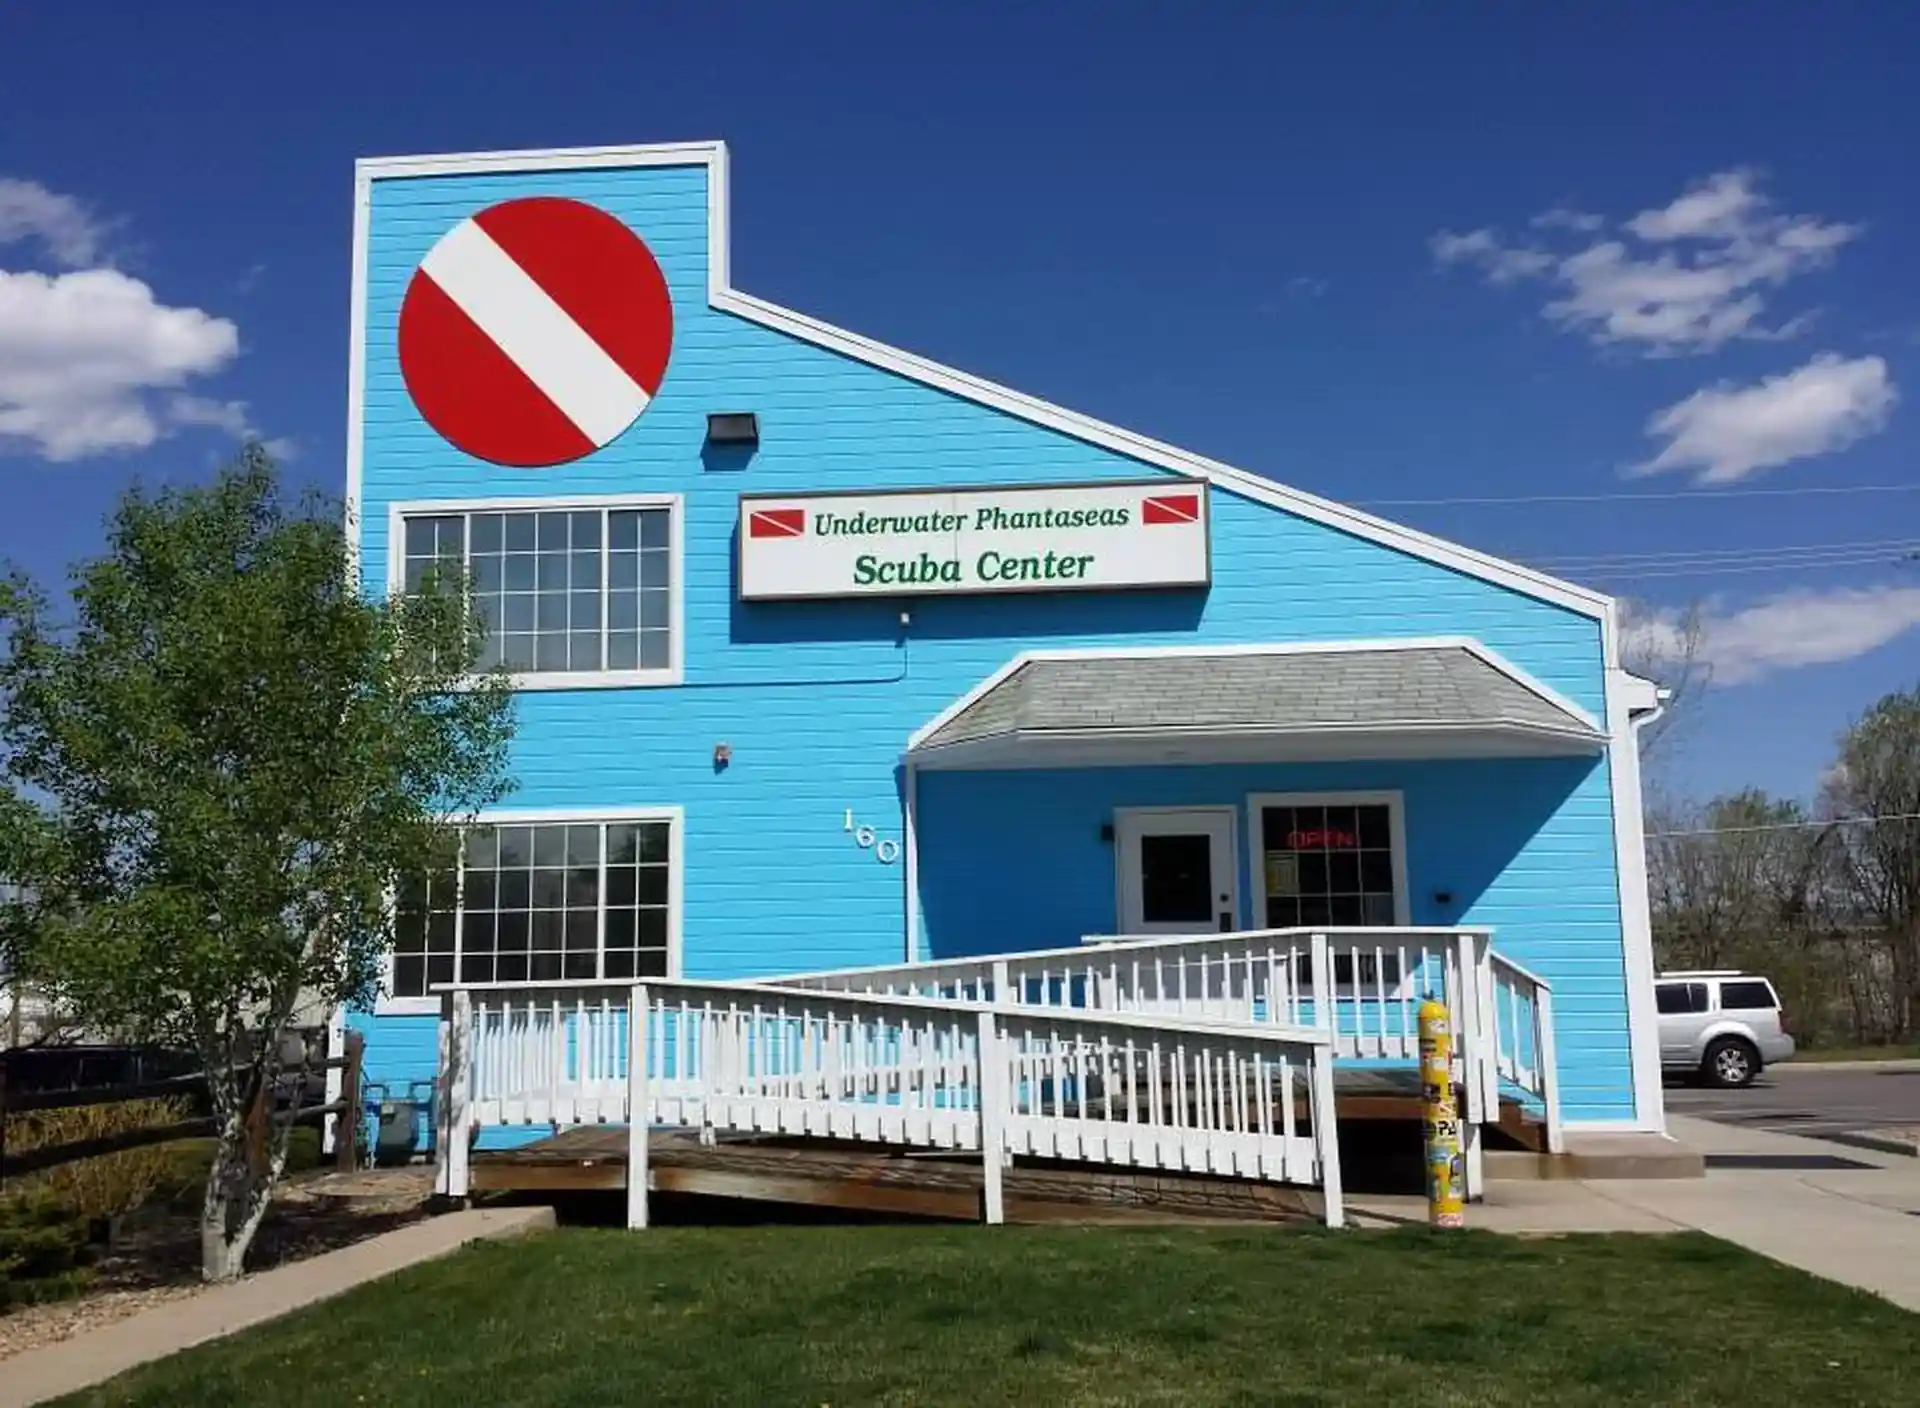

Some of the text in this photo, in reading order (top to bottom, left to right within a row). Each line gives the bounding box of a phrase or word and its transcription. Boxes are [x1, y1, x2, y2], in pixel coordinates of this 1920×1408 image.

[814, 505, 1131, 537] Underwater Phantaseas
[853, 549, 1095, 585] Scuba Center
[843, 808, 900, 862] 160
